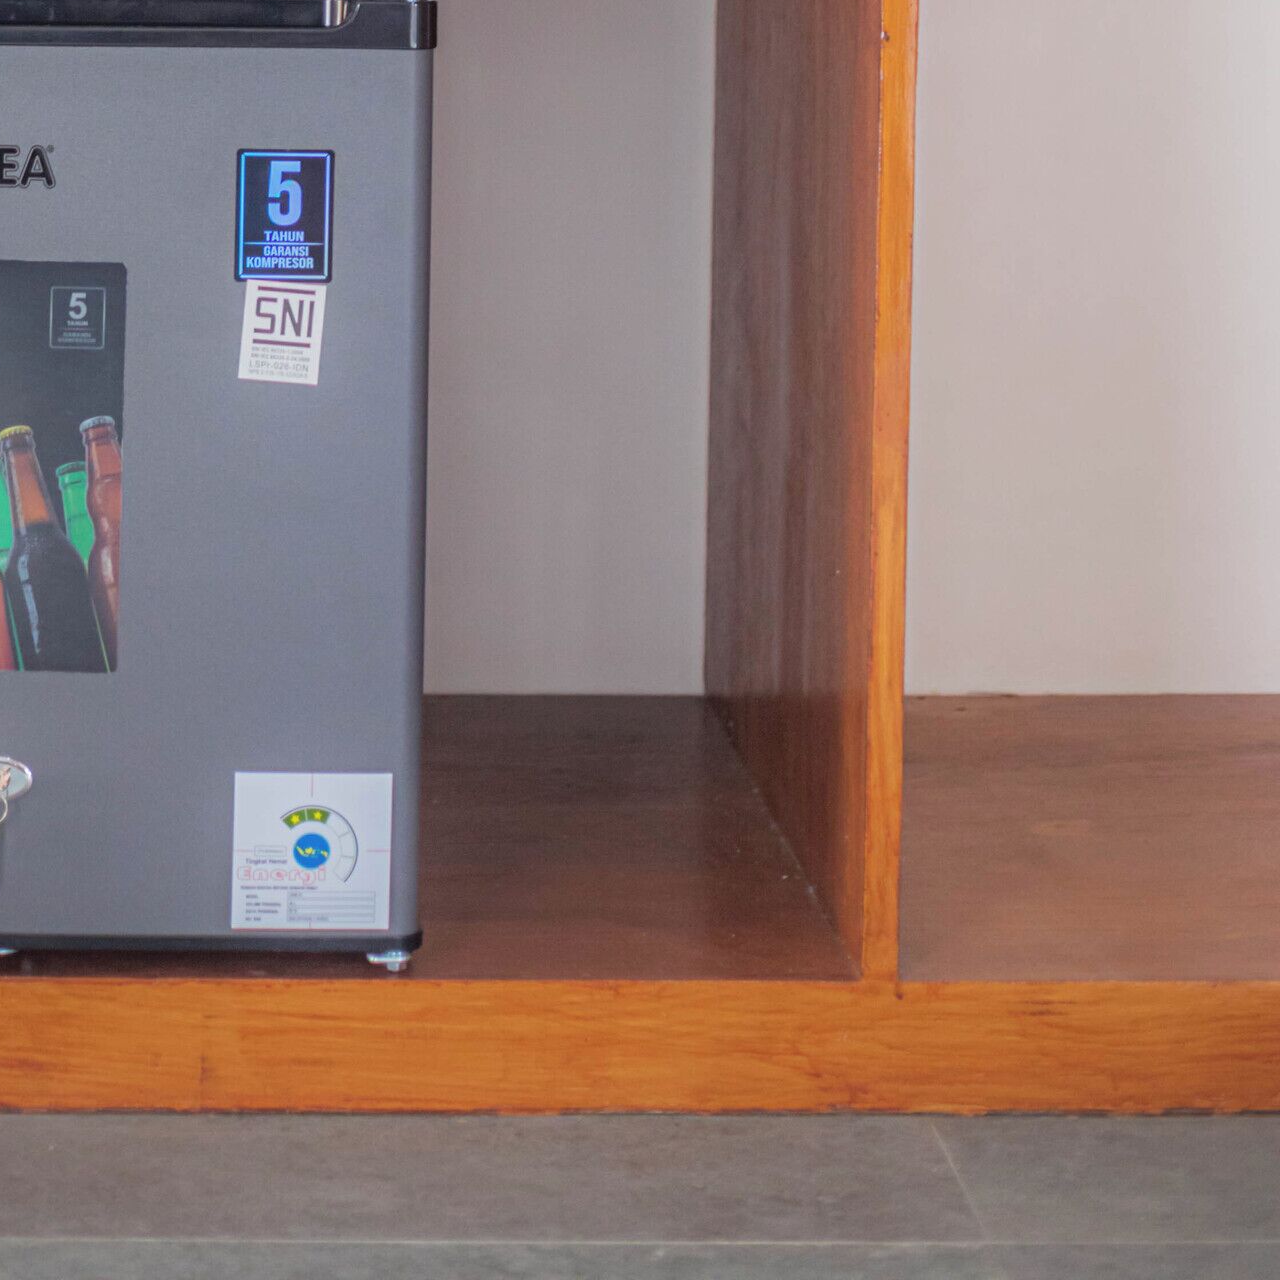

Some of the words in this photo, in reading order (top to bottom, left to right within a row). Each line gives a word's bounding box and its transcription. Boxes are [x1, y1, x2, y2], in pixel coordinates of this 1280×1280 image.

[268, 160, 302, 226] 5
[263, 230, 305, 242] TAHUN
[263, 246, 309, 256] GARANSI
[246, 256, 314, 269] KOMPRESOR
[69, 292, 87, 320] 5
[253, 296, 315, 338] SNI
